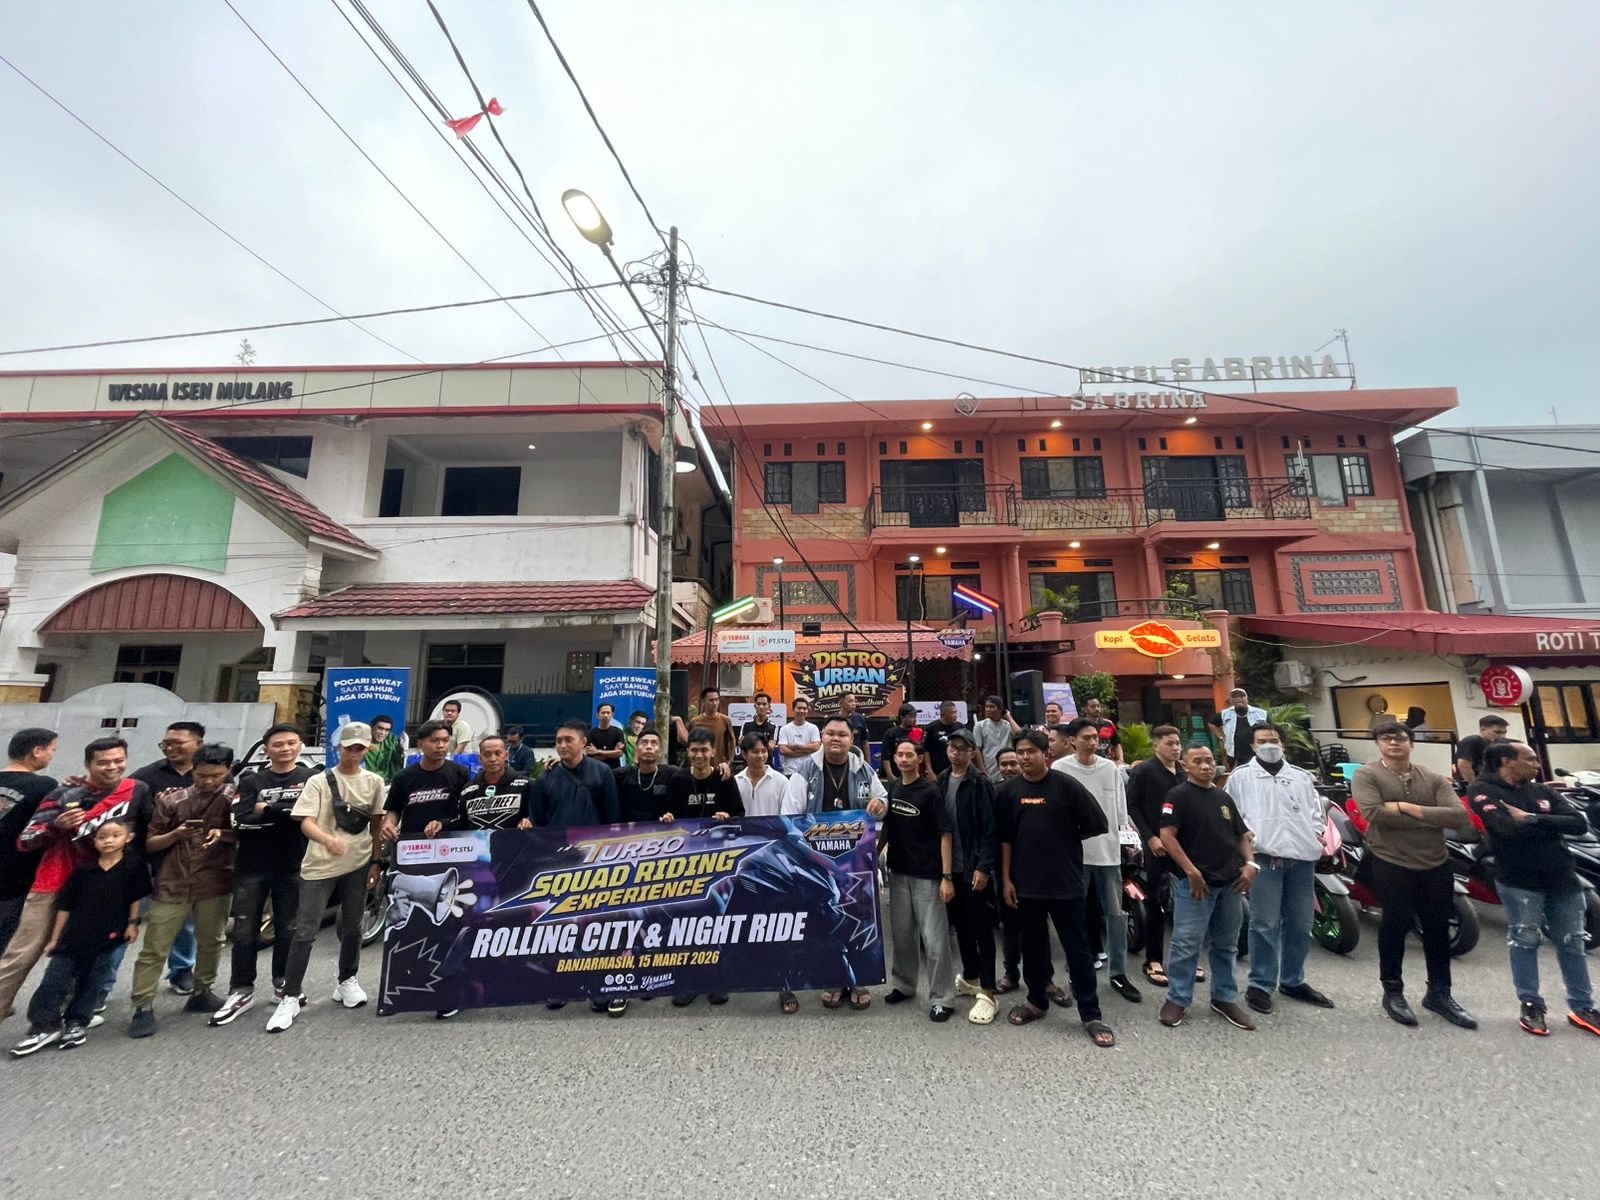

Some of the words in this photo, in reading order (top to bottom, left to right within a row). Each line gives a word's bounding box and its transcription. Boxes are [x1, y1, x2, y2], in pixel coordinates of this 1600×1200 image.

[1082, 366, 1166, 384] HOTEL
[1171, 355, 1342, 381] SABRINA
[108, 383, 168, 401] WISMA
[172, 382, 213, 400] ISEN
[216, 381, 293, 400] MULANG
[1071, 391, 1208, 410] SABRINA
[1103, 635, 1123, 643] Kopi
[1186, 634, 1217, 643] Gelato
[1535, 632, 1584, 650] ROTI
[811, 651, 886, 669] DISTRO
[333, 678, 370, 687] POCARI
[371, 678, 403, 687] SWEAT
[813, 667, 886, 687] URBAN
[340, 685, 362, 694] SAAT
[604, 683, 623, 691] SAAT
[817, 683, 879, 698] MARKET
[334, 693, 356, 703] JAGA
[357, 692, 373, 700] ION
[815, 839, 851, 851] YAMAHA
[522, 865, 631, 899] SQUAD
[633, 848, 749, 884] RIDING
[549, 876, 714, 915] EXPERIENCE
[470, 922, 580, 959] ROLLING
[581, 919, 643, 952] CITY
[643, 922, 664, 948] &
[667, 915, 748, 947] NIGHT
[749, 911, 808, 944] RIDE
[556, 953, 636, 973] BANJARMASIN,
[638, 953, 652, 969] 15
[652, 951, 690, 967] MARET
[690, 950, 720, 965] 2026
